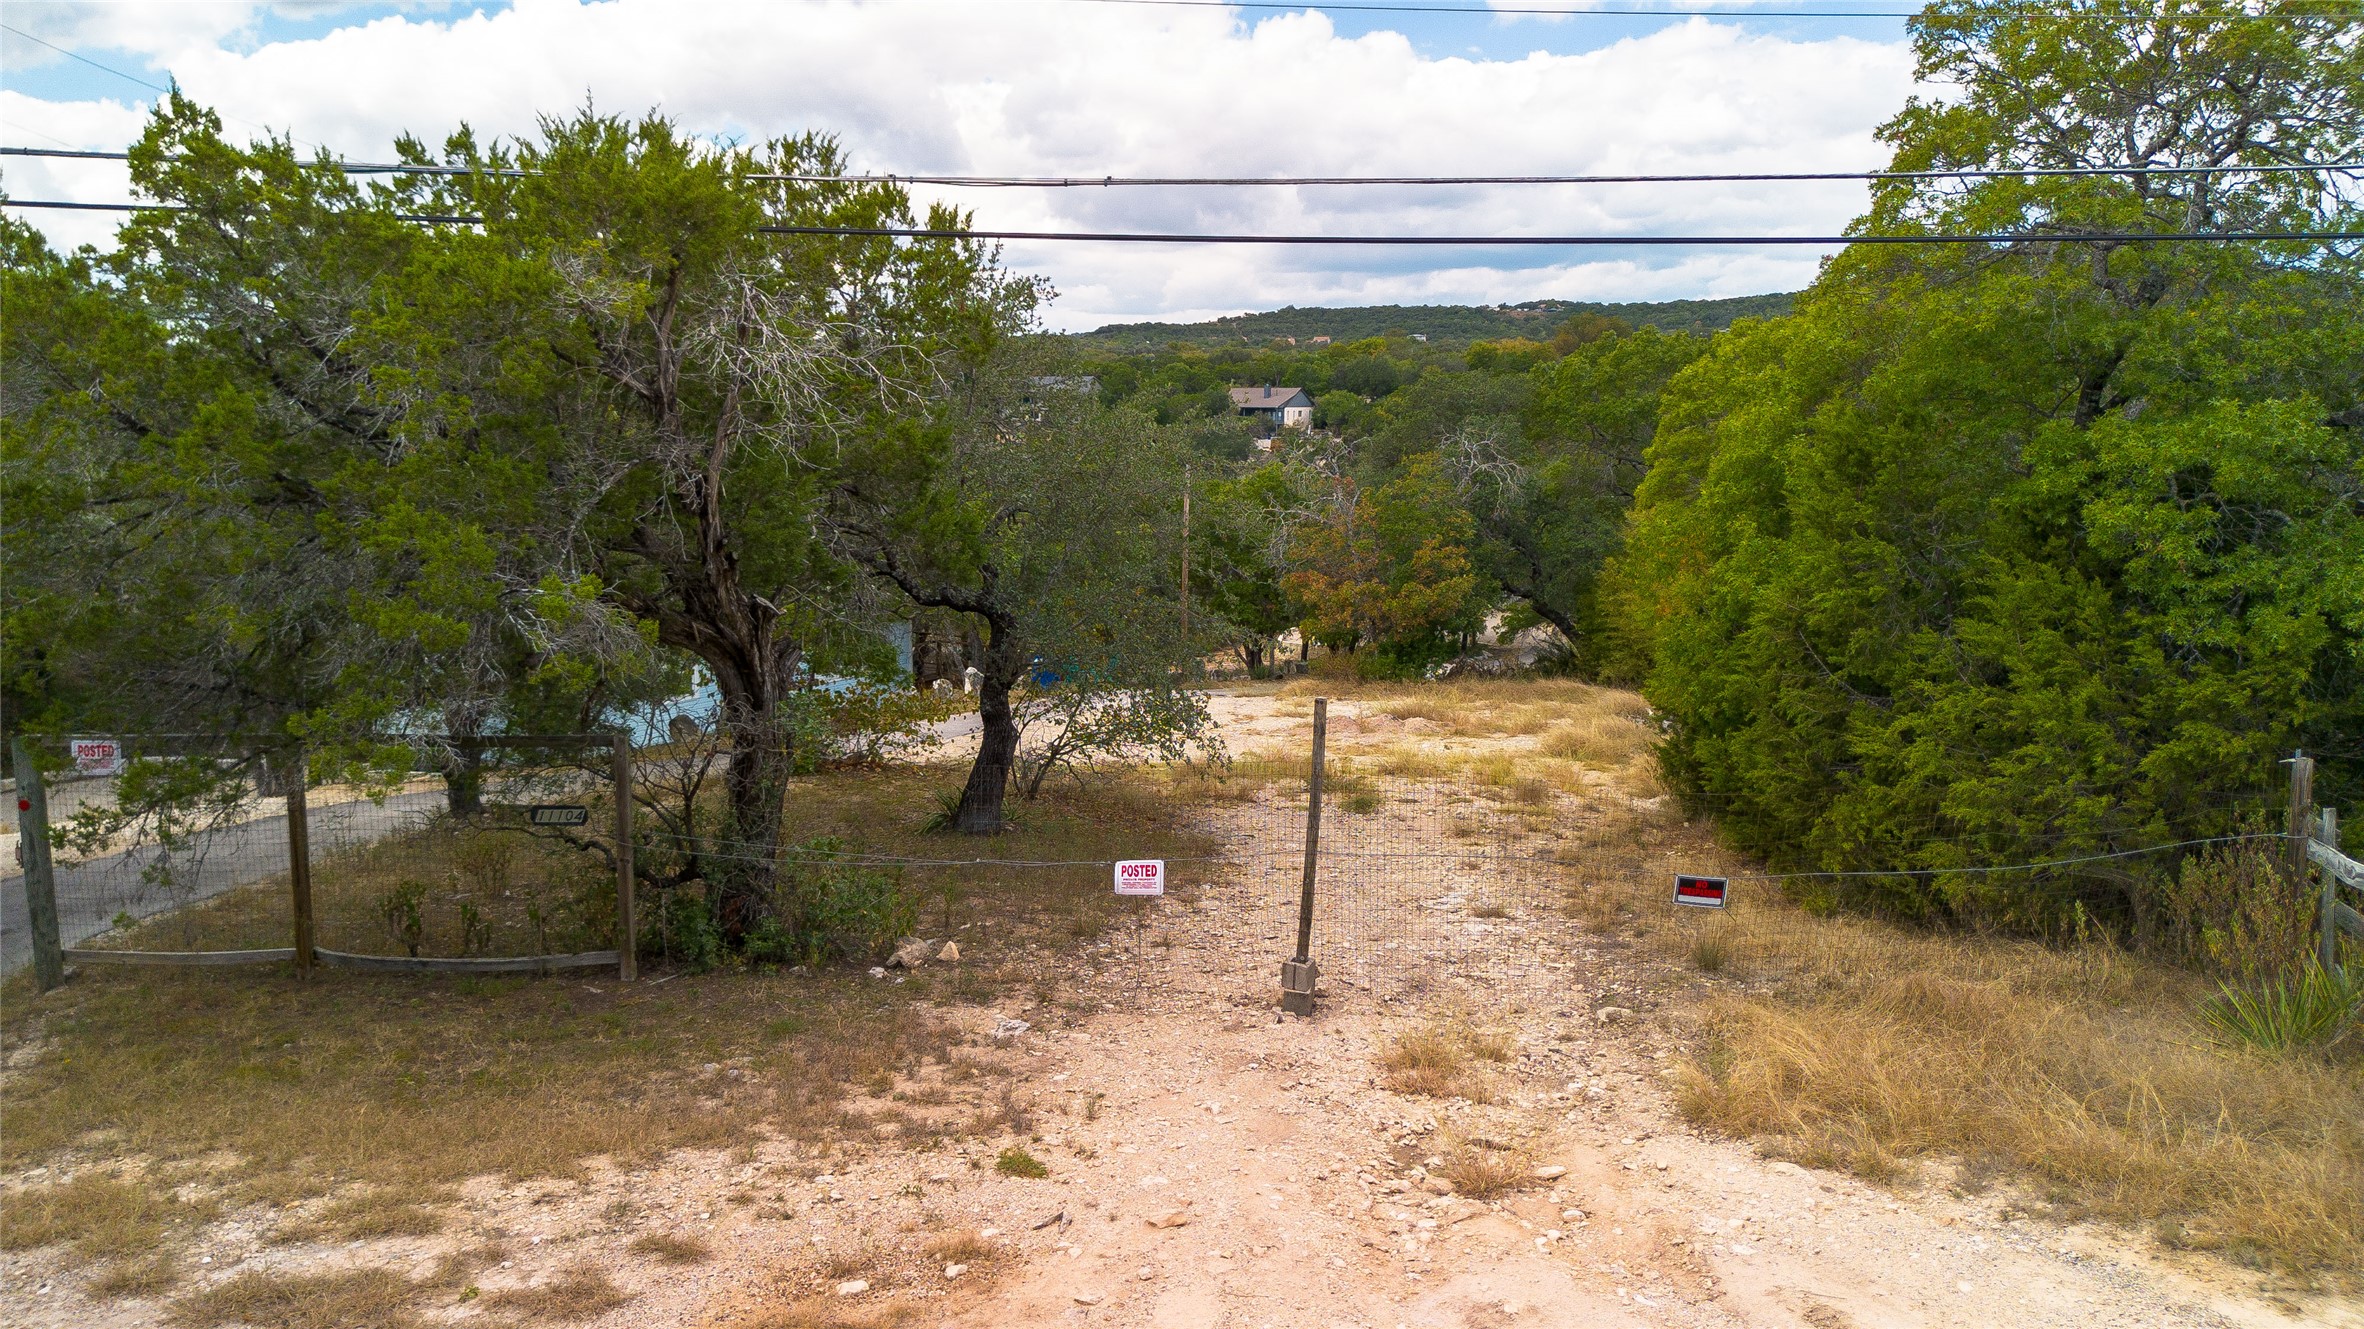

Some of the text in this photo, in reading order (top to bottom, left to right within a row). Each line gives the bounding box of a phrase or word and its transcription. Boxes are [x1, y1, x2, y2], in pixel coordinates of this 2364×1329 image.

[77, 744, 114, 757] POSTED
[540, 810, 584, 821] 11104
[1121, 864, 1157, 877] POSTED
[1695, 880, 1708, 889] NO
[1679, 887, 1723, 898] TRESPASSING
